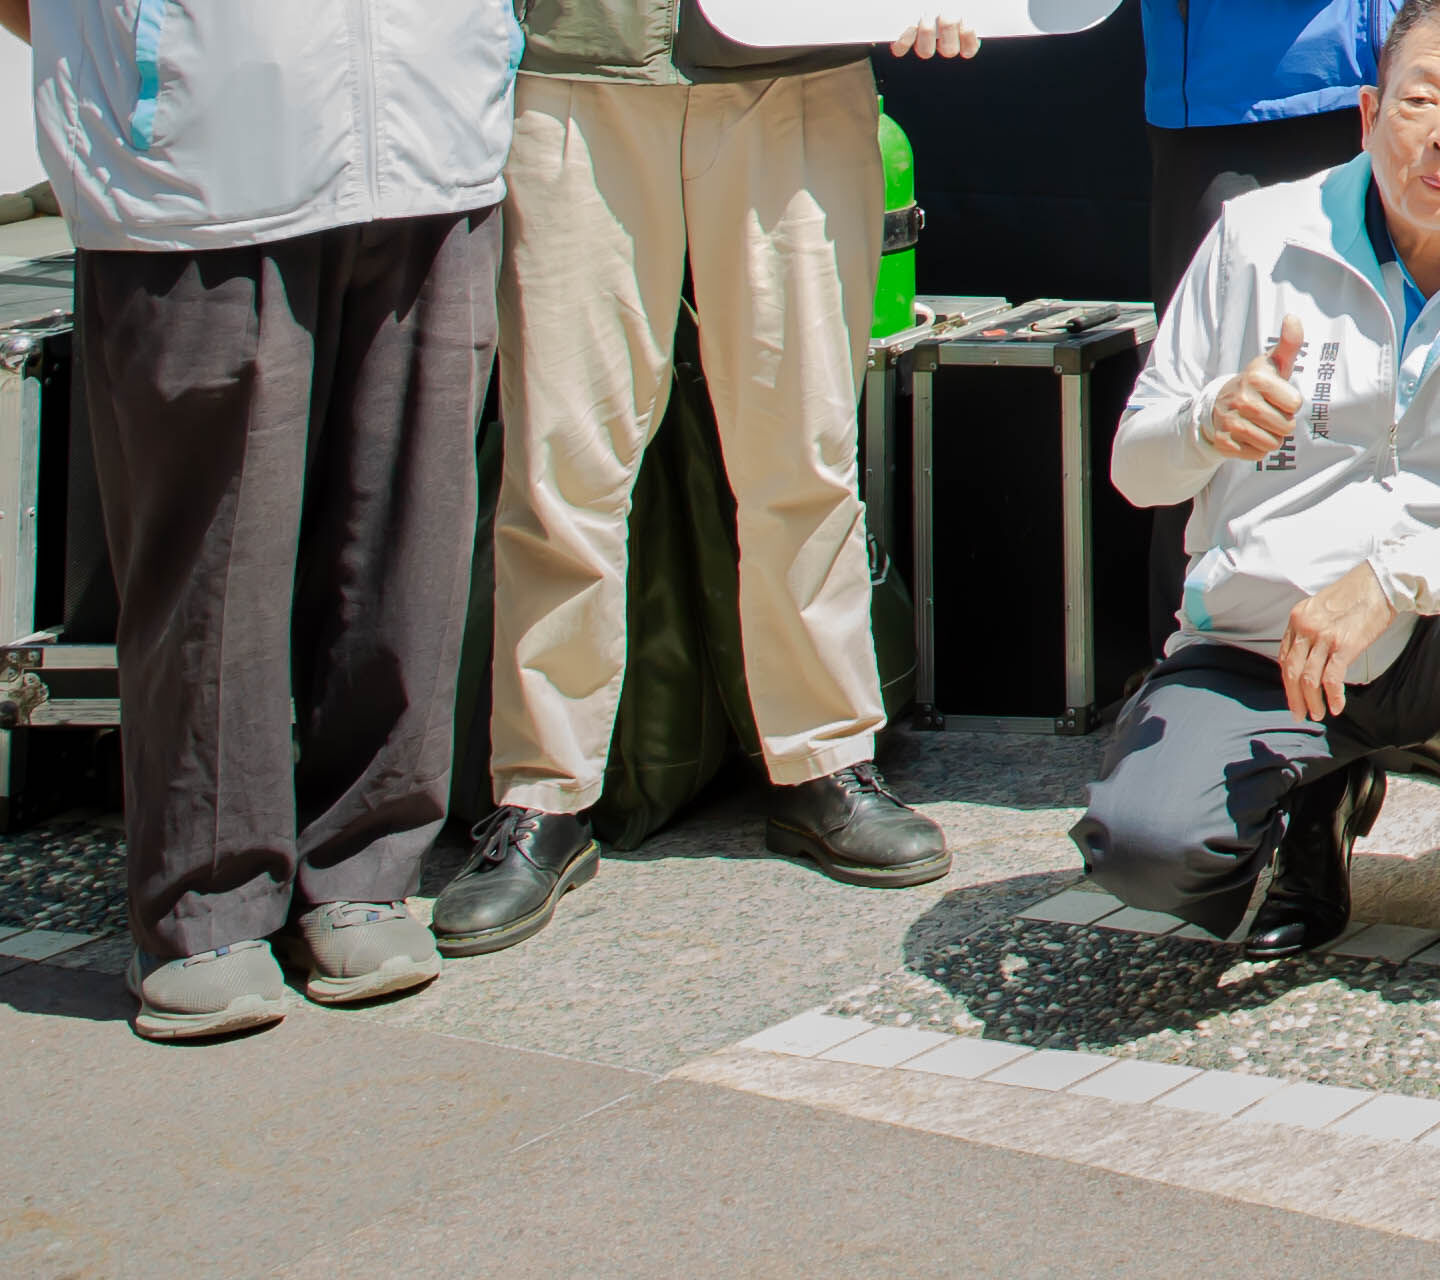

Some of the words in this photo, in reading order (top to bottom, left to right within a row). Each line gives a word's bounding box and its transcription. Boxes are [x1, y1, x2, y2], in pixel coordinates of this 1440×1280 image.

[1311, 342, 1340, 440] 關帝里里長
